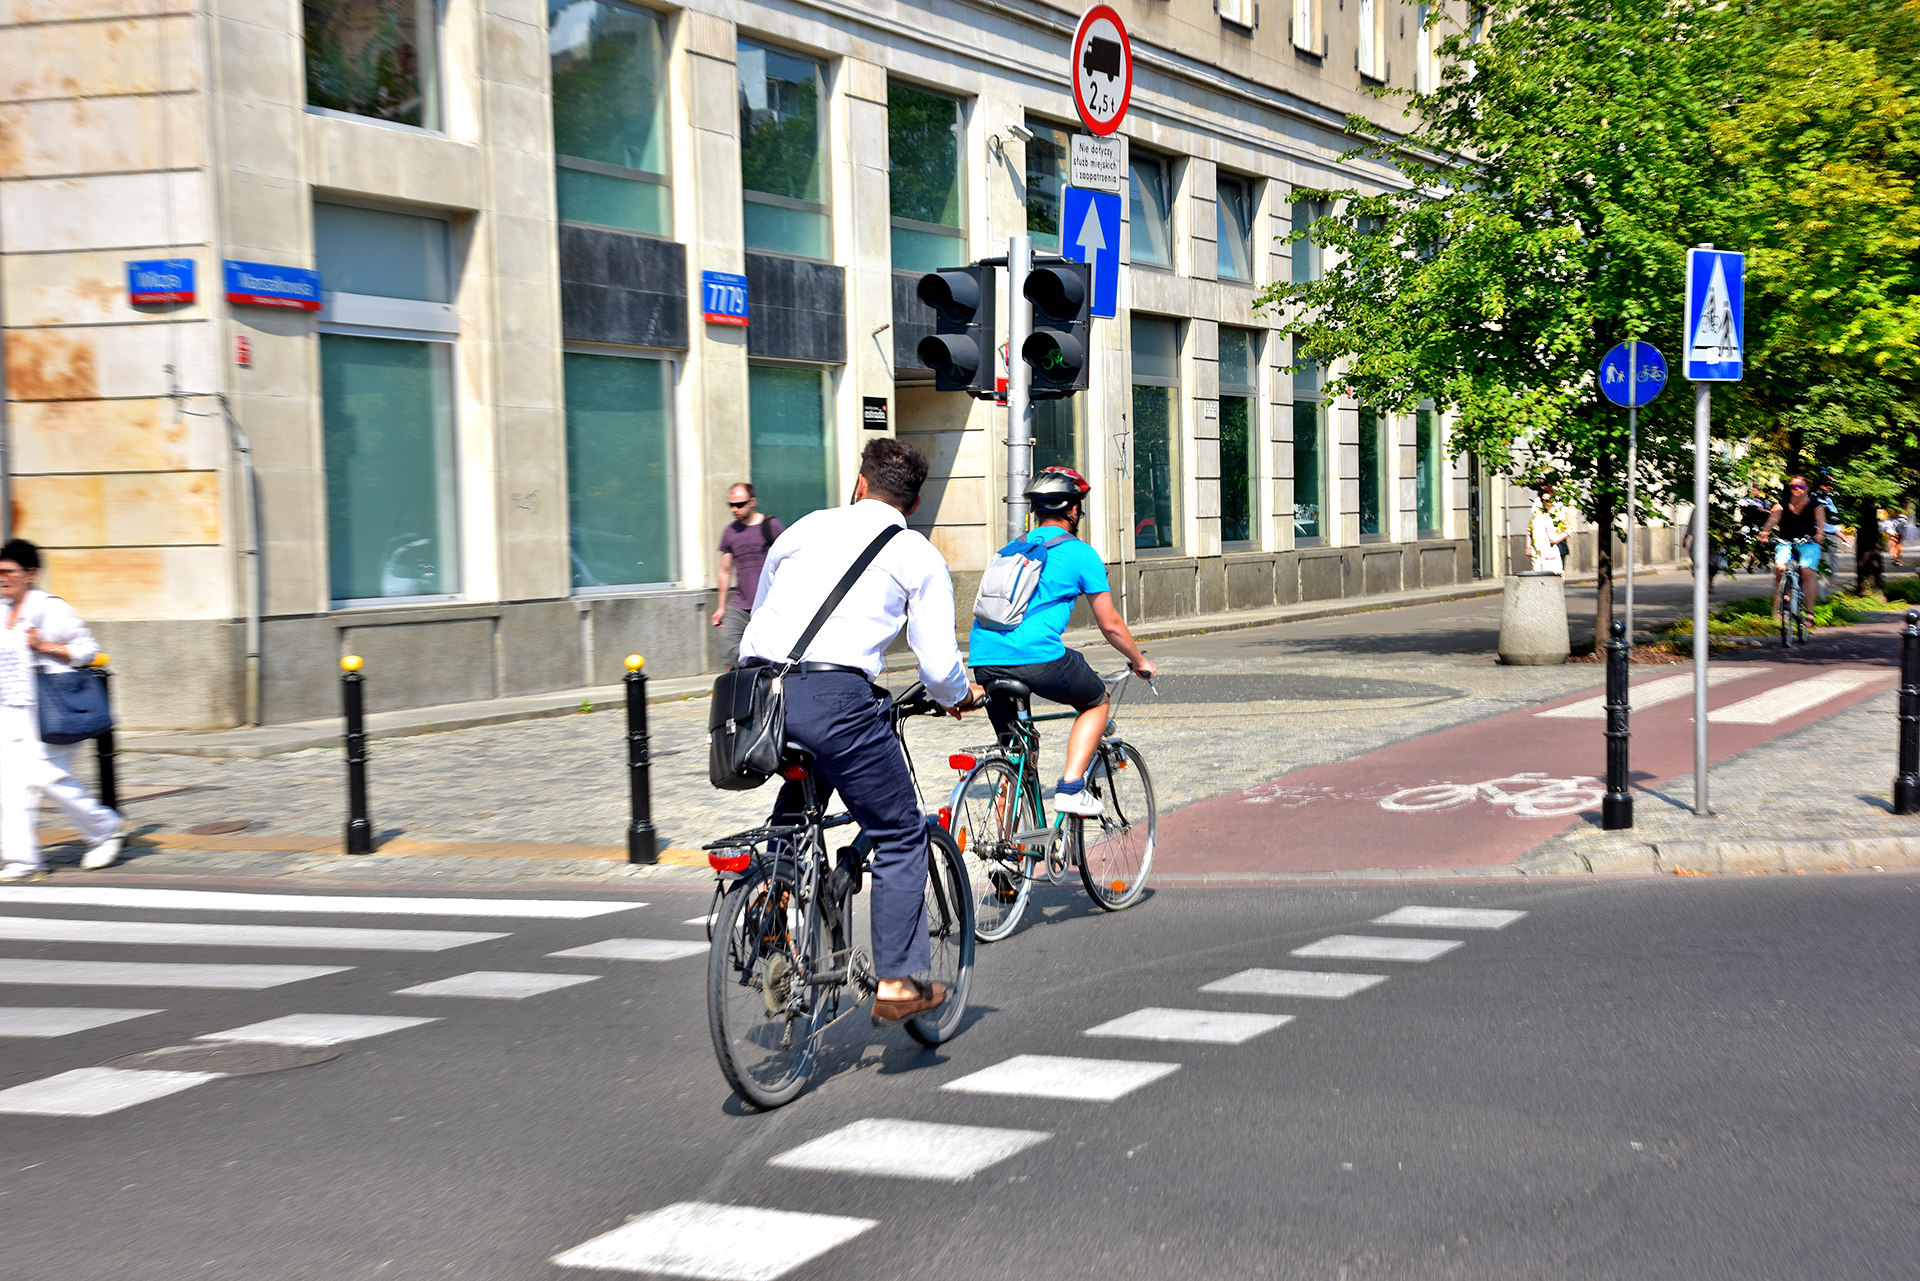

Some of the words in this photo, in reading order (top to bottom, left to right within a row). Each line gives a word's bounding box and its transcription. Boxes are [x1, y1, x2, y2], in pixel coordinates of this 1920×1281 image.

[1079, 142, 1089, 153] Nie
[1091, 145, 1114, 158] dotyczy
[1090, 160, 1117, 170] miejskich
[1079, 171, 1117, 183] zaopatrzenia
